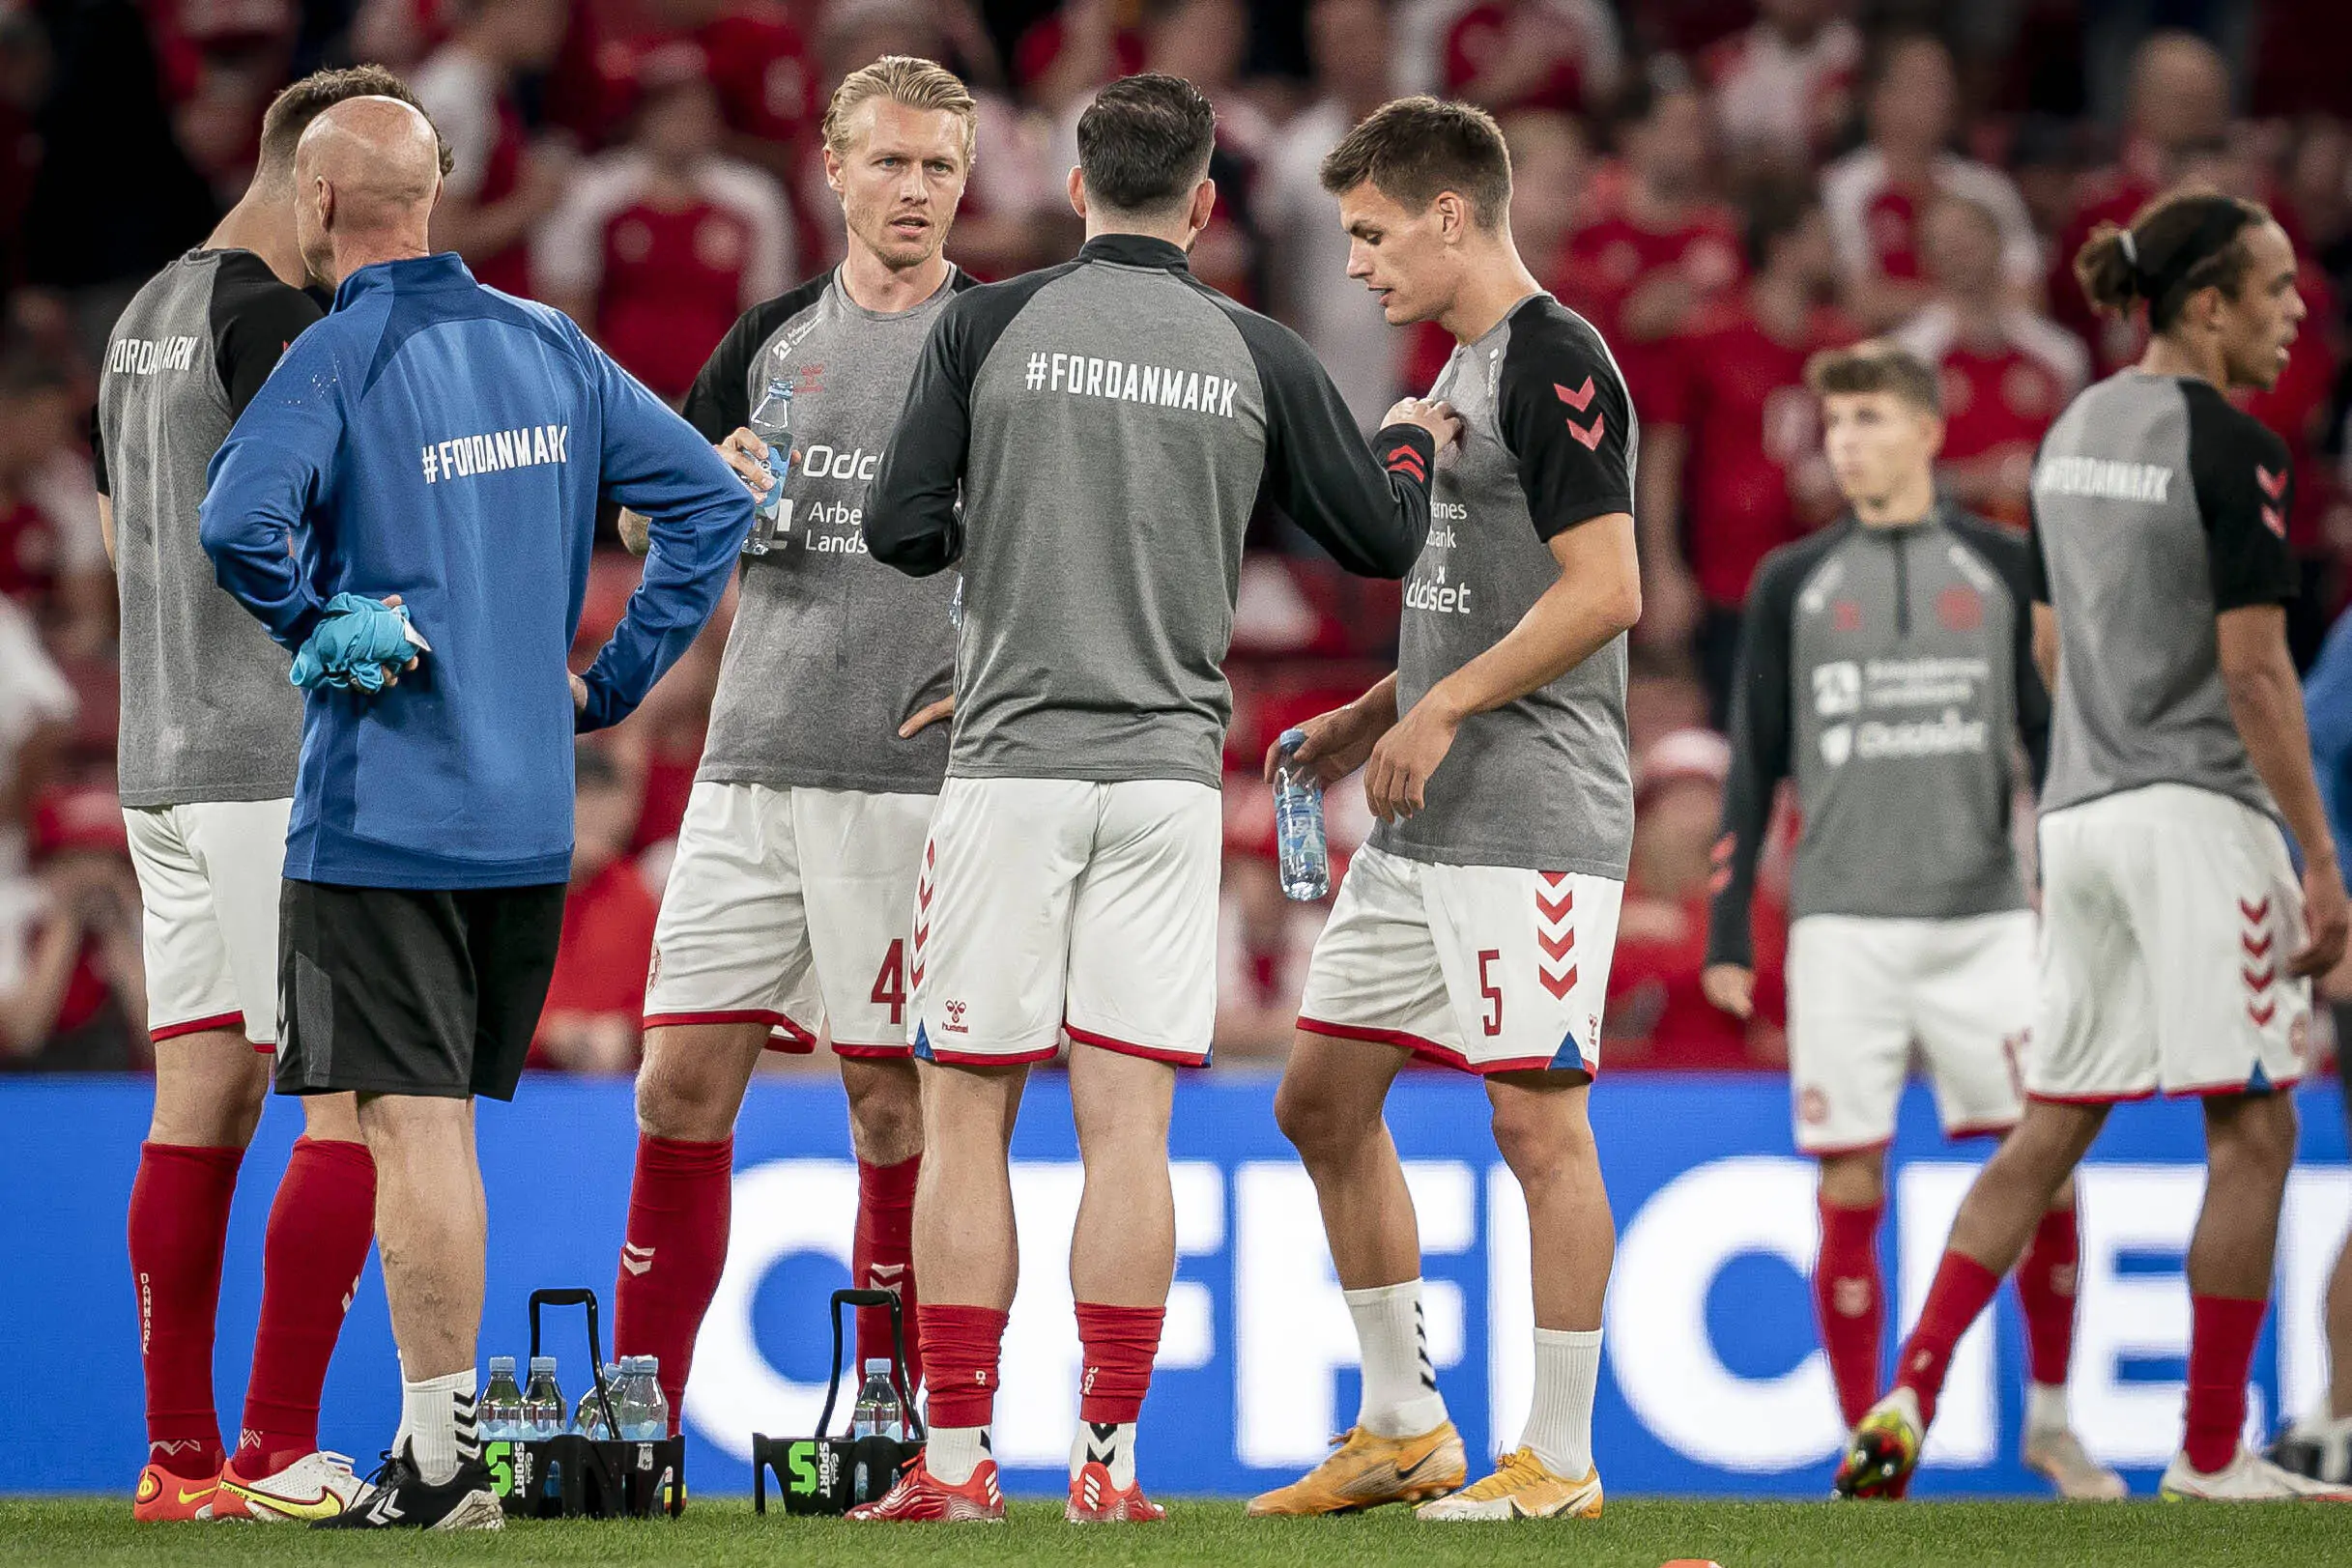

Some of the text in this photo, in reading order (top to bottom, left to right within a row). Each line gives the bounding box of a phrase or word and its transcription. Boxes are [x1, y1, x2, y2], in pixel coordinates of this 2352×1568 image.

[1025, 352, 1238, 418] #FORDANMARK
[422, 425, 568, 484] #FORDANMARK
[805, 528, 868, 554] Lands
[871, 938, 906, 1025] 4
[1477, 949, 1504, 1037] 5
[514, 1441, 527, 1498] SPORT
[818, 1441, 831, 1498] SPORT
